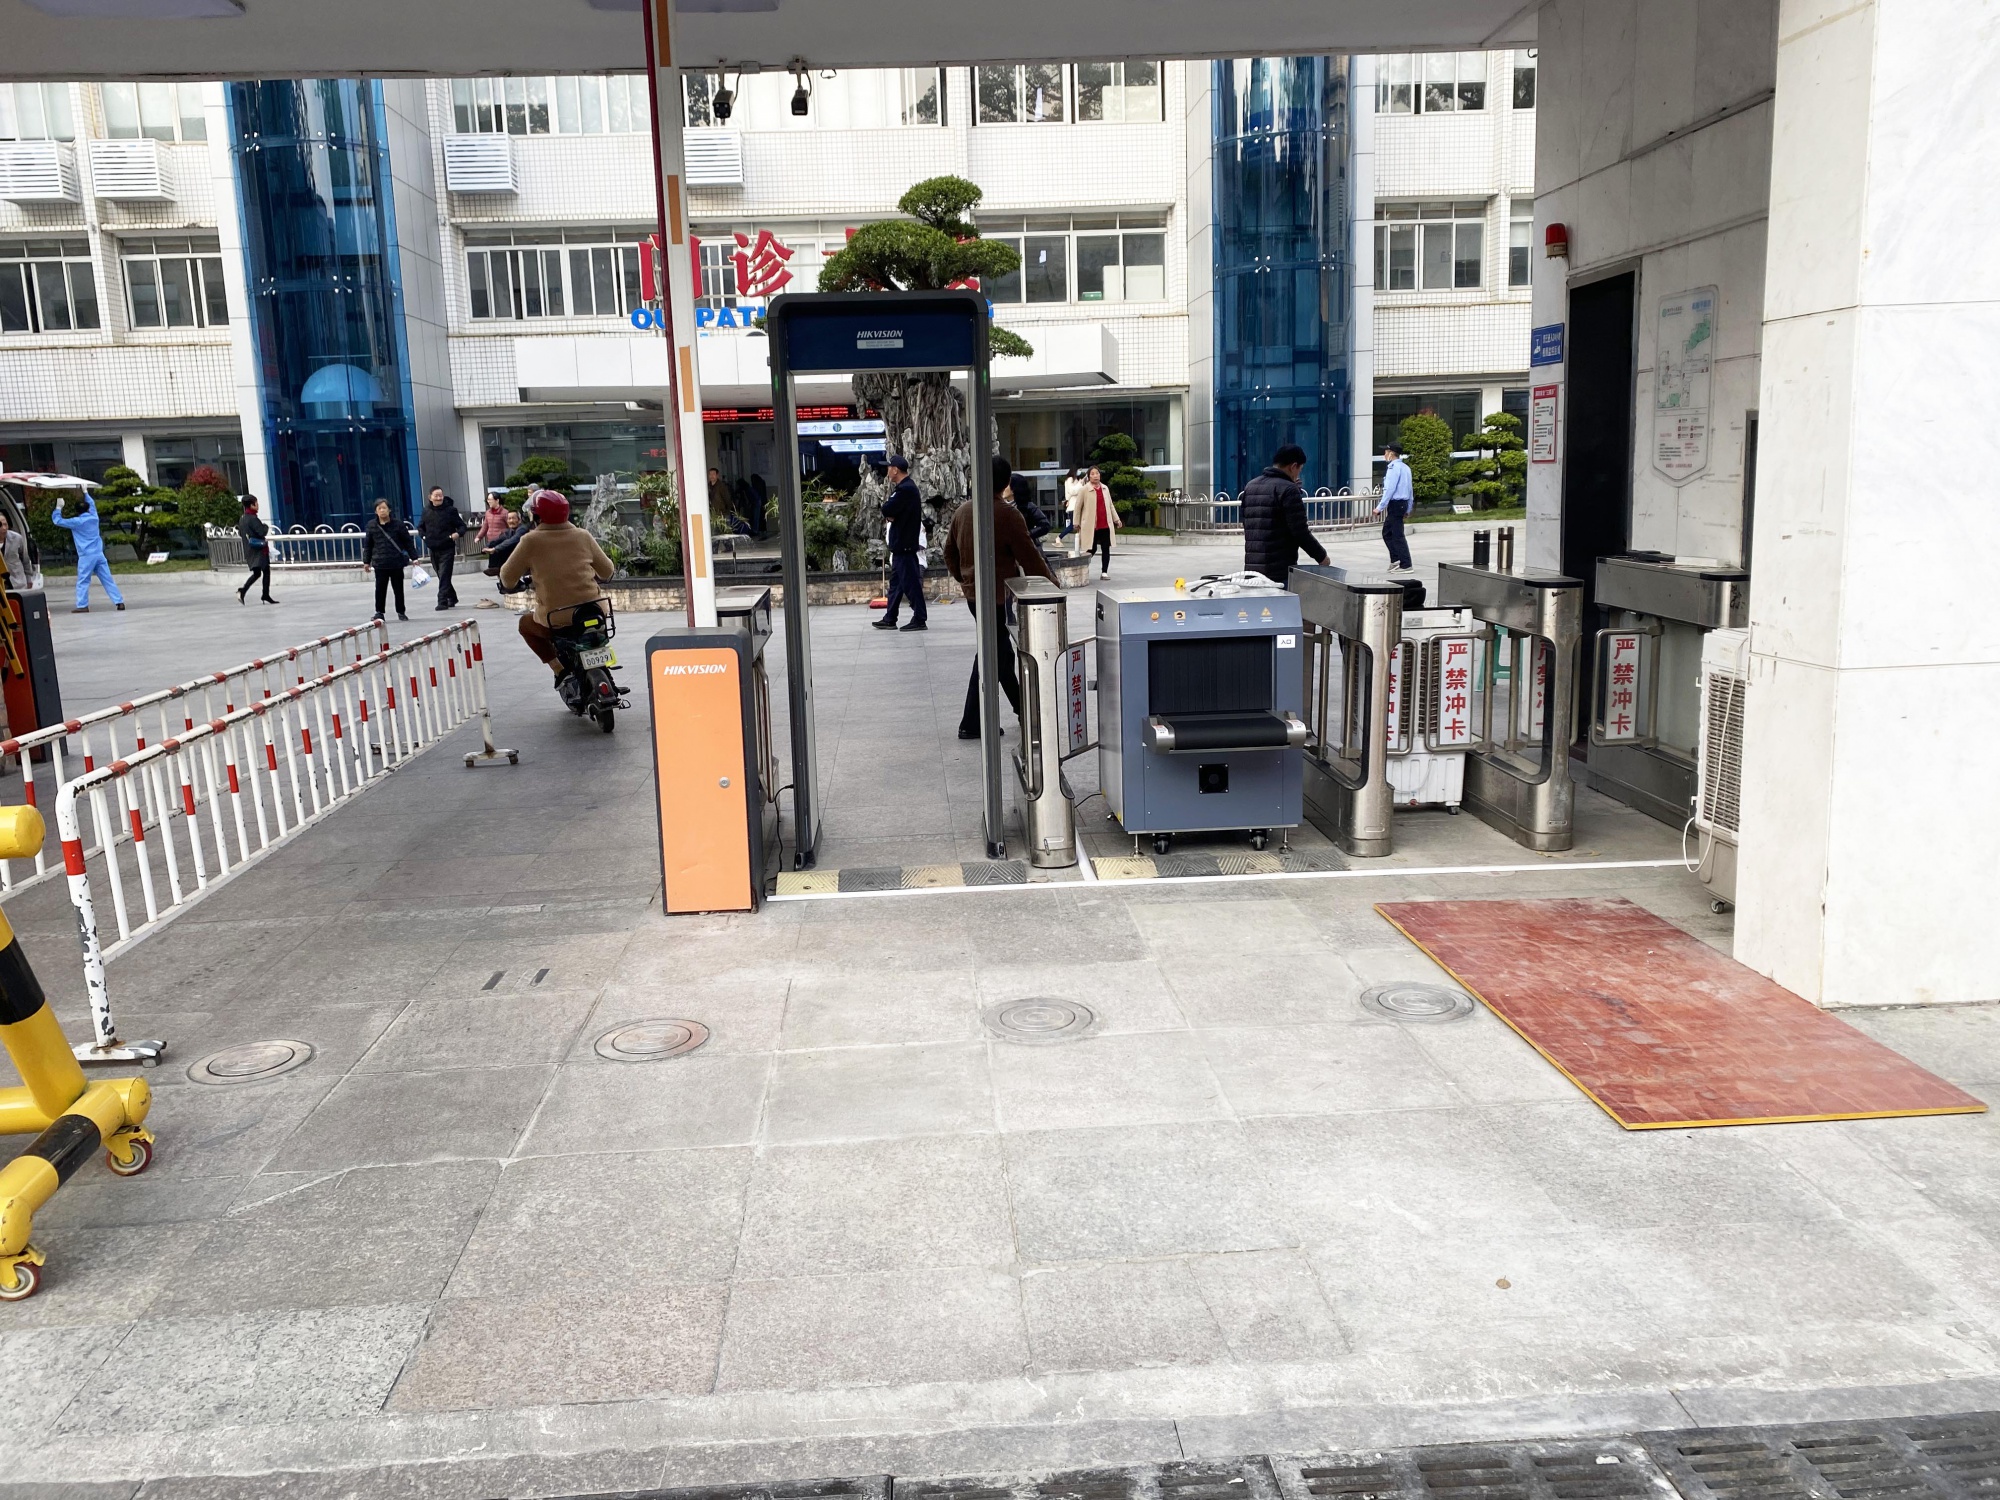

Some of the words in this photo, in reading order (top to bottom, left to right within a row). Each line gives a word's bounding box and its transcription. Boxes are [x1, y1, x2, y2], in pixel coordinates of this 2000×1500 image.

[856, 329, 904, 339] HIKVISION
[663, 663, 728, 676] HIKVISION
[1071, 650, 1084, 744] 严禁冲卡
[1444, 643, 1469, 741] 严禁冲卡
[1610, 638, 1636, 735] 严禁冲卡
